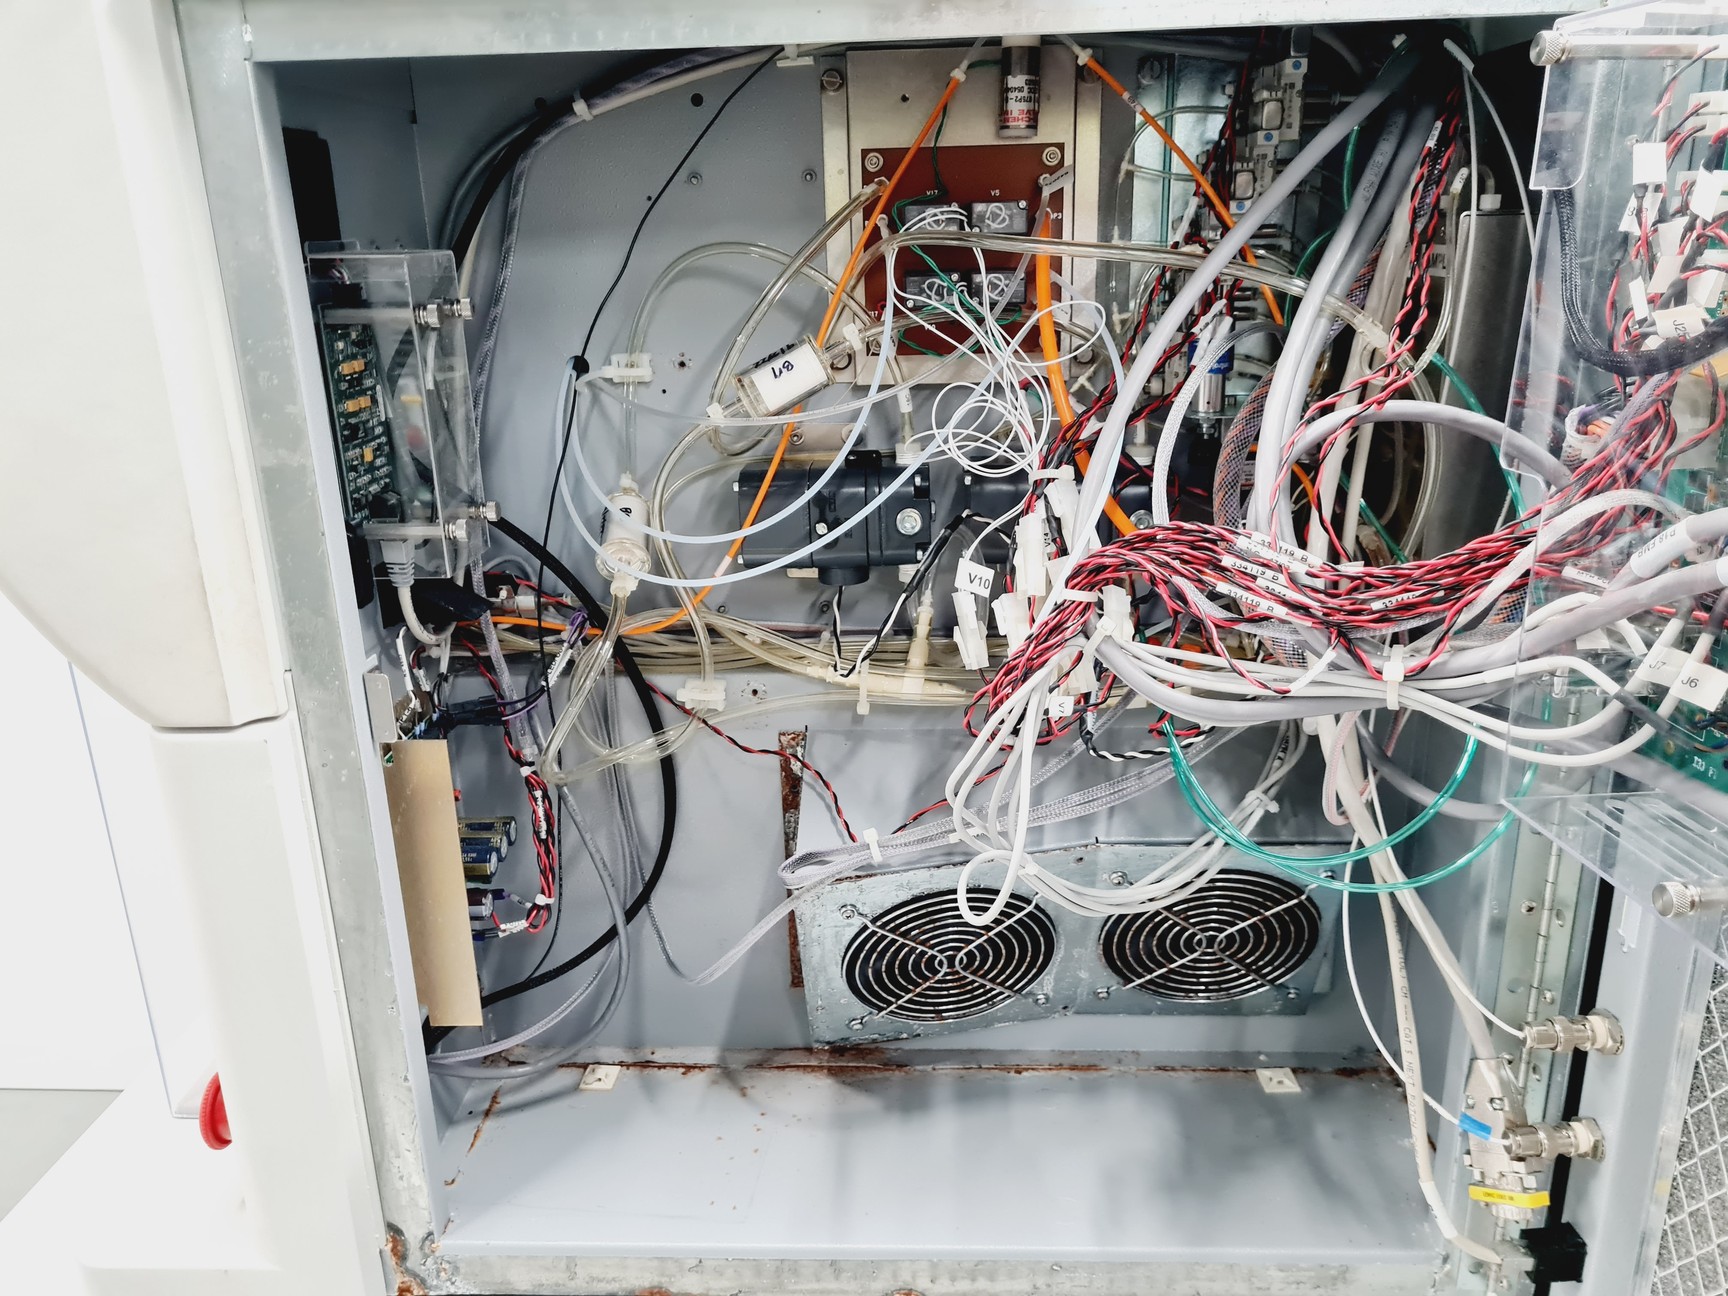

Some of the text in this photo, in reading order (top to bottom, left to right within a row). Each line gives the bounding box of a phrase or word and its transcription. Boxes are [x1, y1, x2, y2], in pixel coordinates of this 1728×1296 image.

[990, 189, 1000, 197] V5
[968, 571, 991, 590] V10
[1648, 658, 1667, 673] J7
[1681, 675, 1700, 689] J6
[1057, 700, 1066, 715] V7
[1405, 1060, 1417, 1088] NEXT
